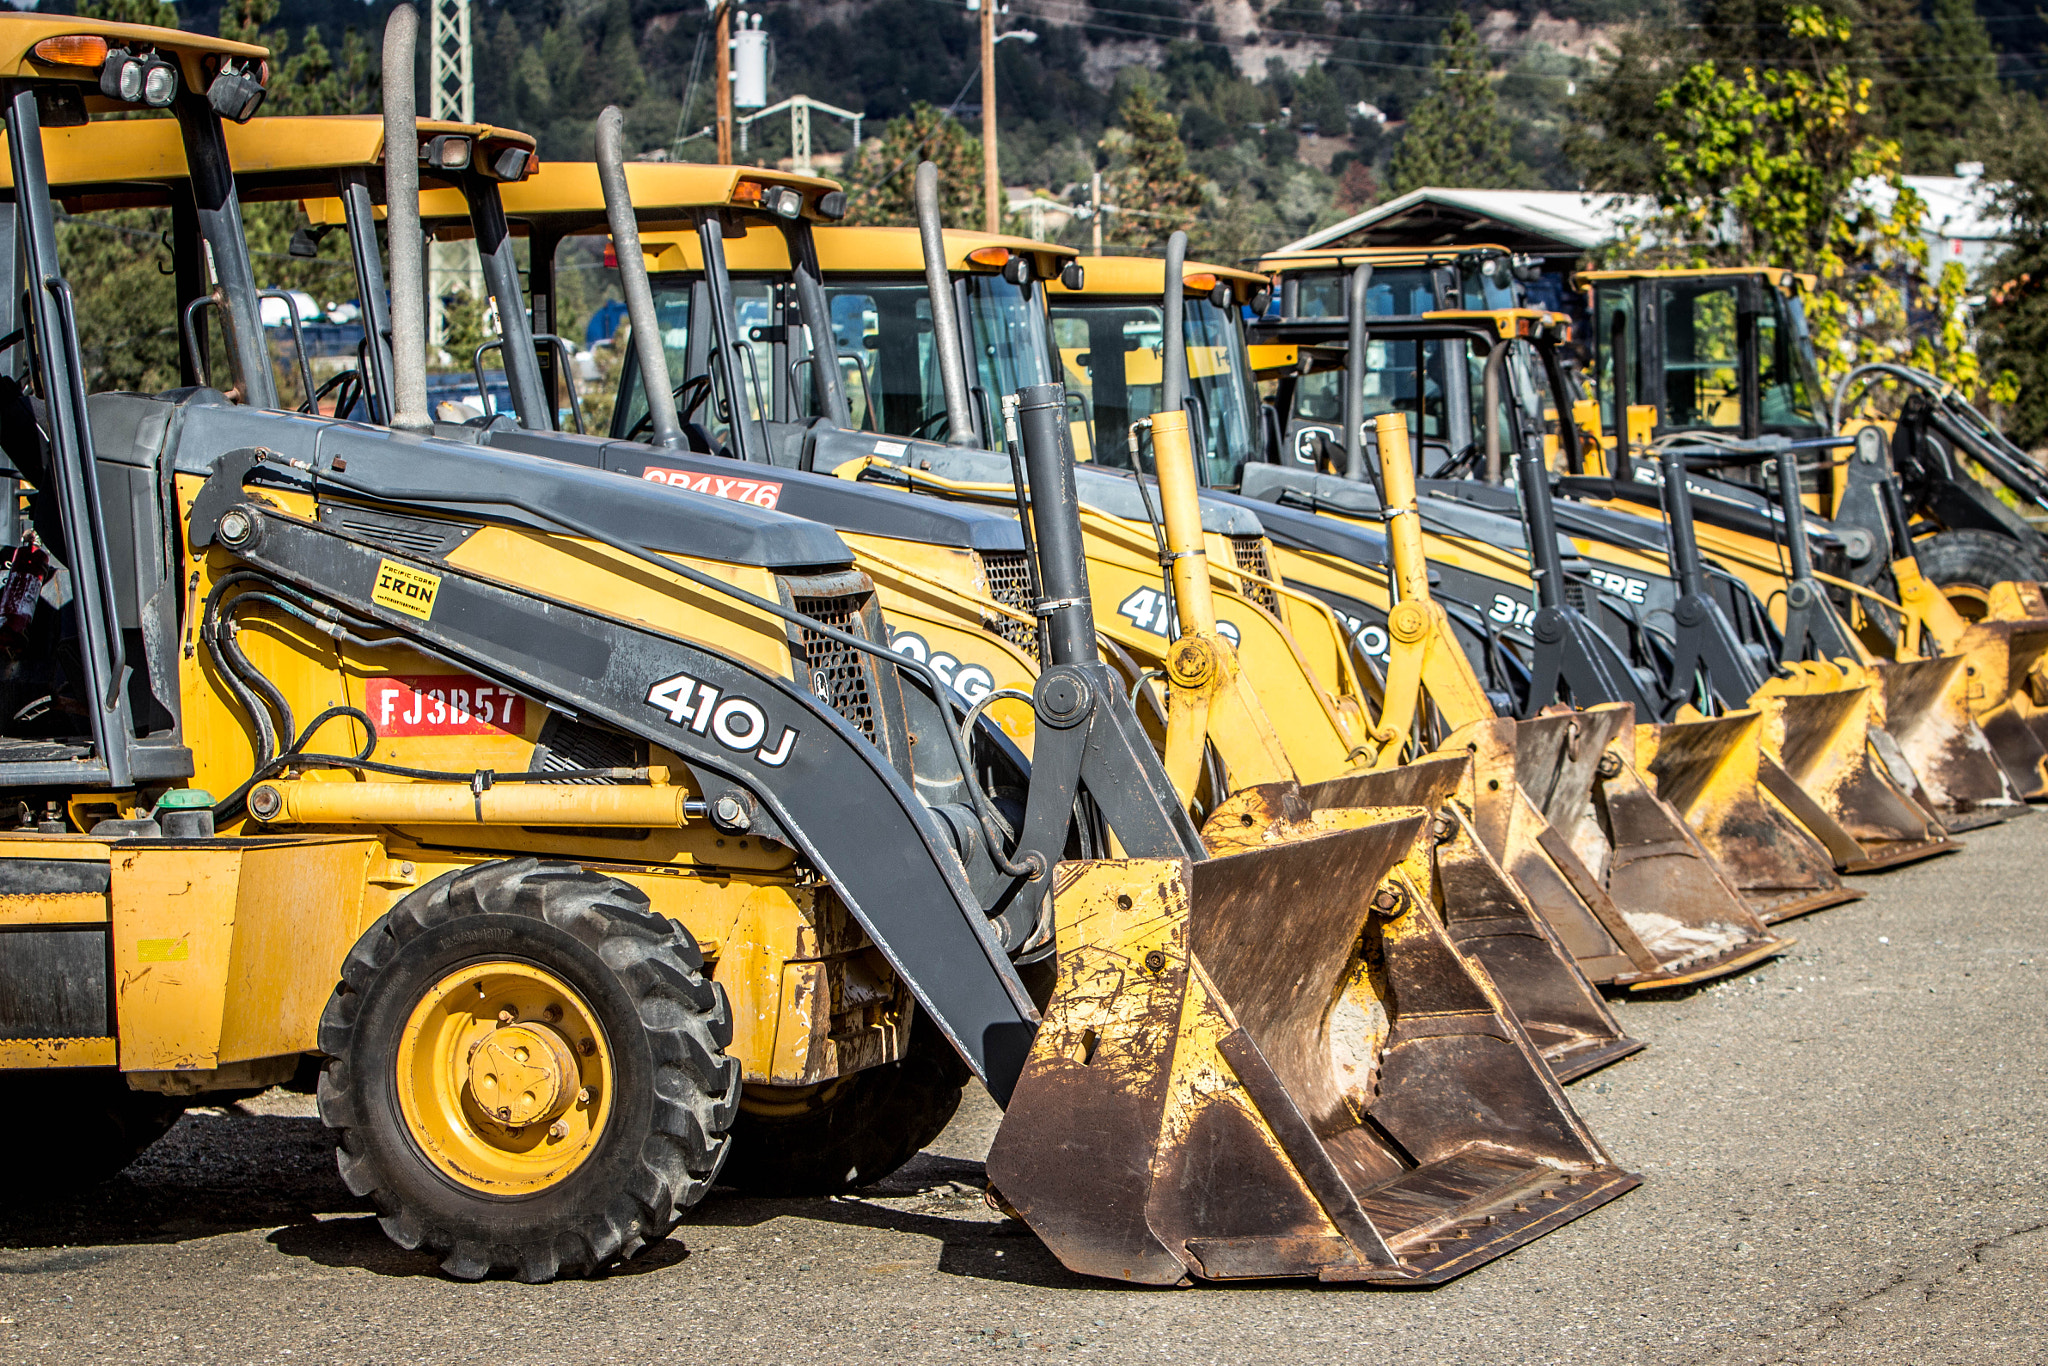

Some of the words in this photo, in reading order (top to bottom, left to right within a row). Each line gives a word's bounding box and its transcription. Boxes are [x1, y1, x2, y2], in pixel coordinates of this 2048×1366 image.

[379, 574, 433, 603] IRON
[384, 565, 411, 578] PACIFIC
[414, 576, 436, 586] COAST
[381, 688, 515, 725] FJ3B57
[646, 674, 798, 767] 410J
